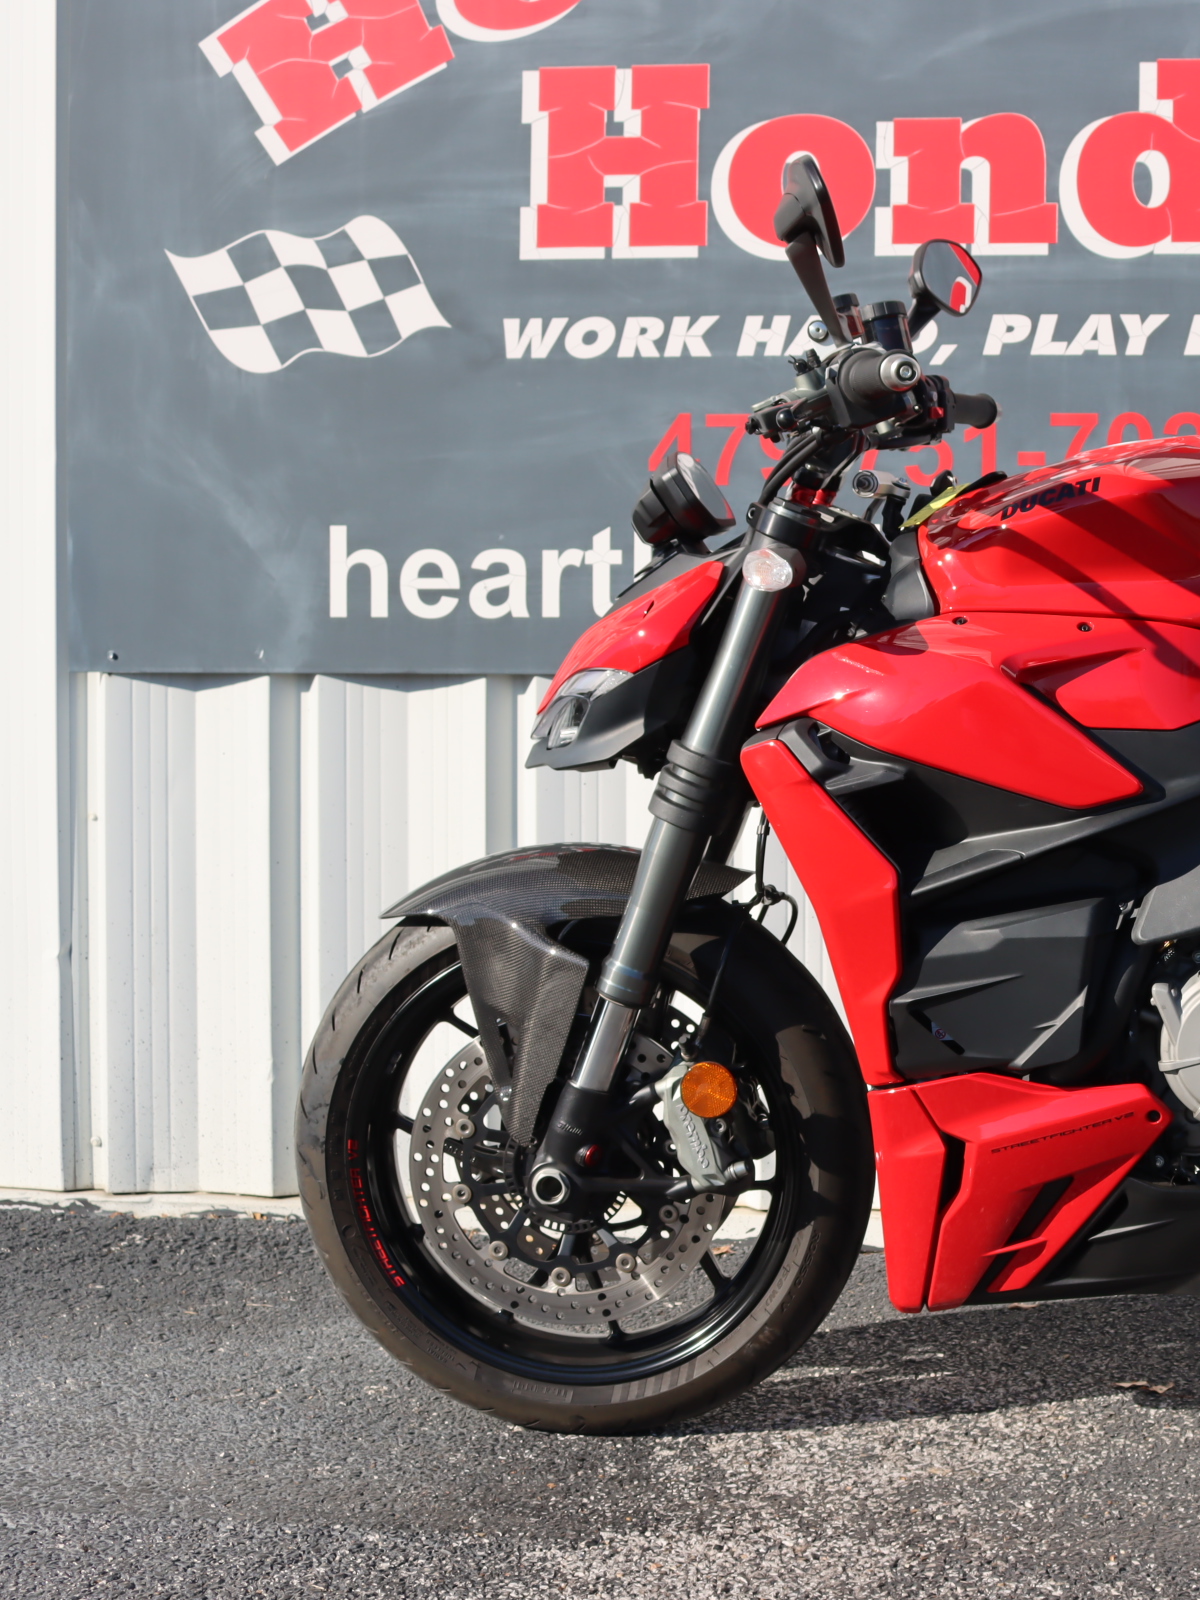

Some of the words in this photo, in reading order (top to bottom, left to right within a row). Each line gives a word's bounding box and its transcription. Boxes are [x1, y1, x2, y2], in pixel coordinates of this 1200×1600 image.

[502, 315, 720, 359] WORK
[982, 313, 1170, 356] PLAY
[1001, 477, 1101, 521] DUCATI
[991, 1118, 1112, 1154] STREETFIGHTER
[1116, 1112, 1135, 1121] V2
